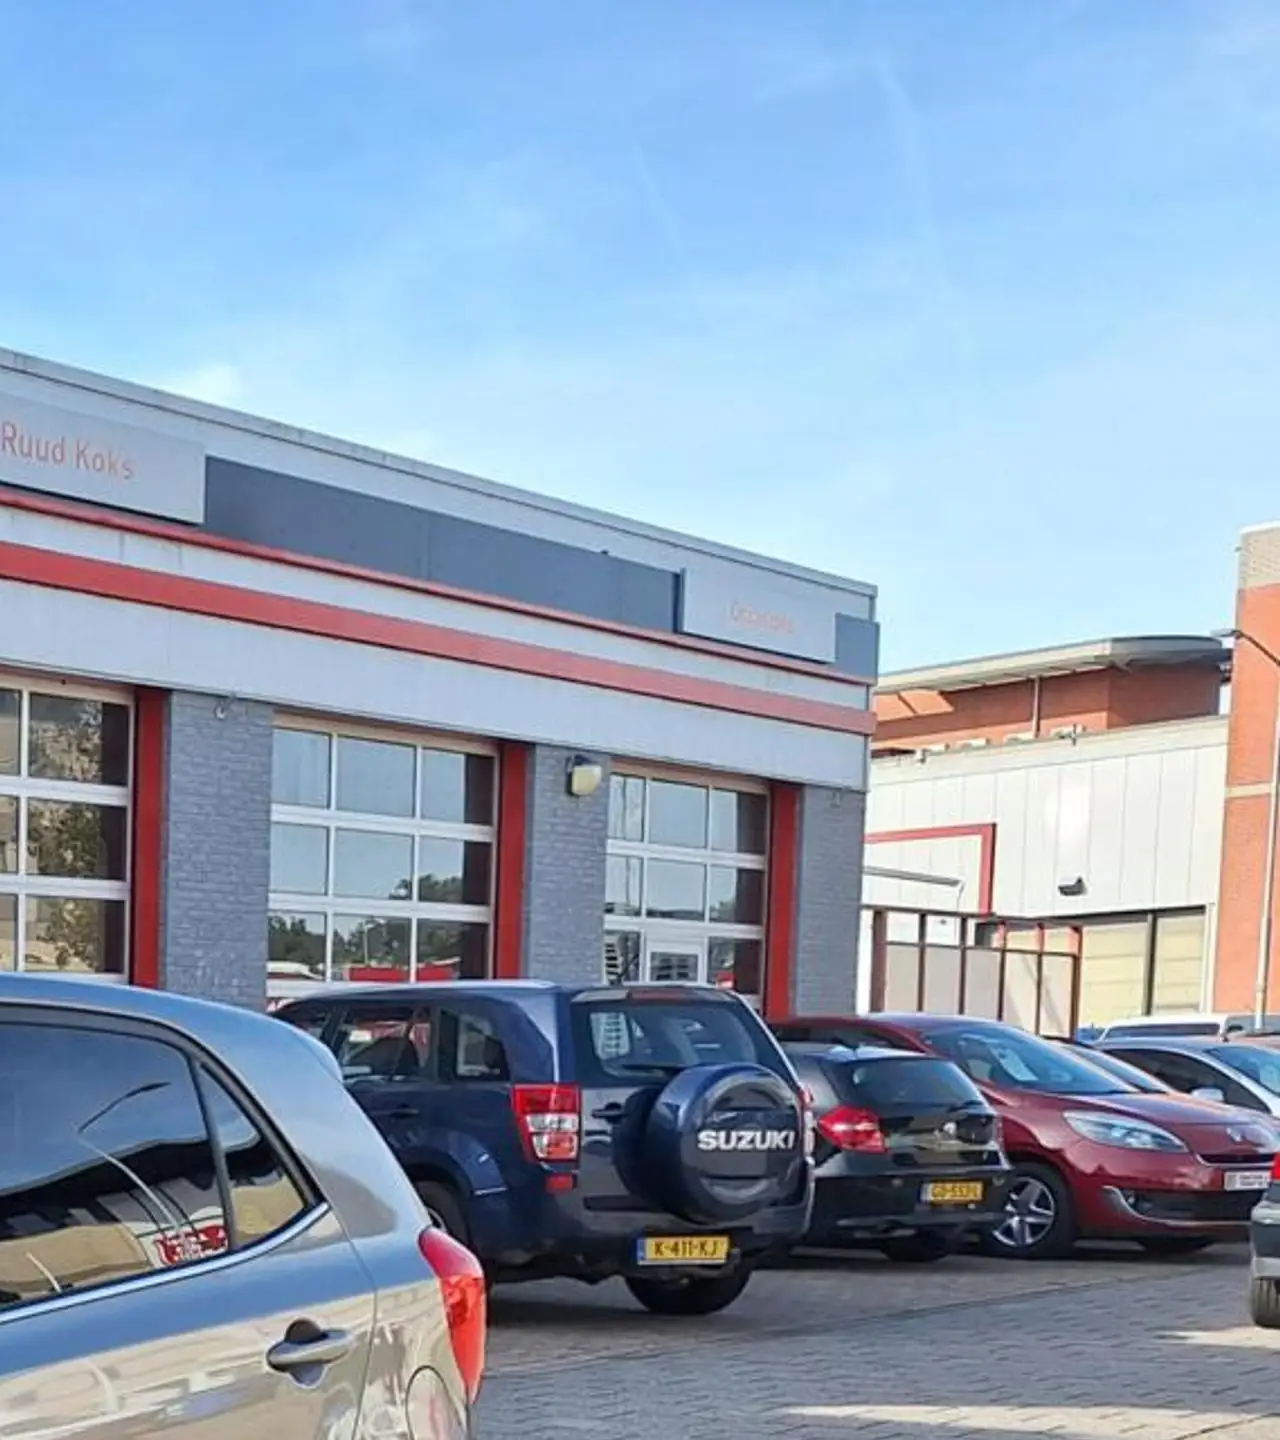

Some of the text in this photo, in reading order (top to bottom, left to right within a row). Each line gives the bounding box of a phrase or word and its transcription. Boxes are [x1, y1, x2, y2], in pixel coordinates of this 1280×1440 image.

[0, 421, 134, 480] Ruud Koks
[697, 1130, 796, 1151] SUZUKI
